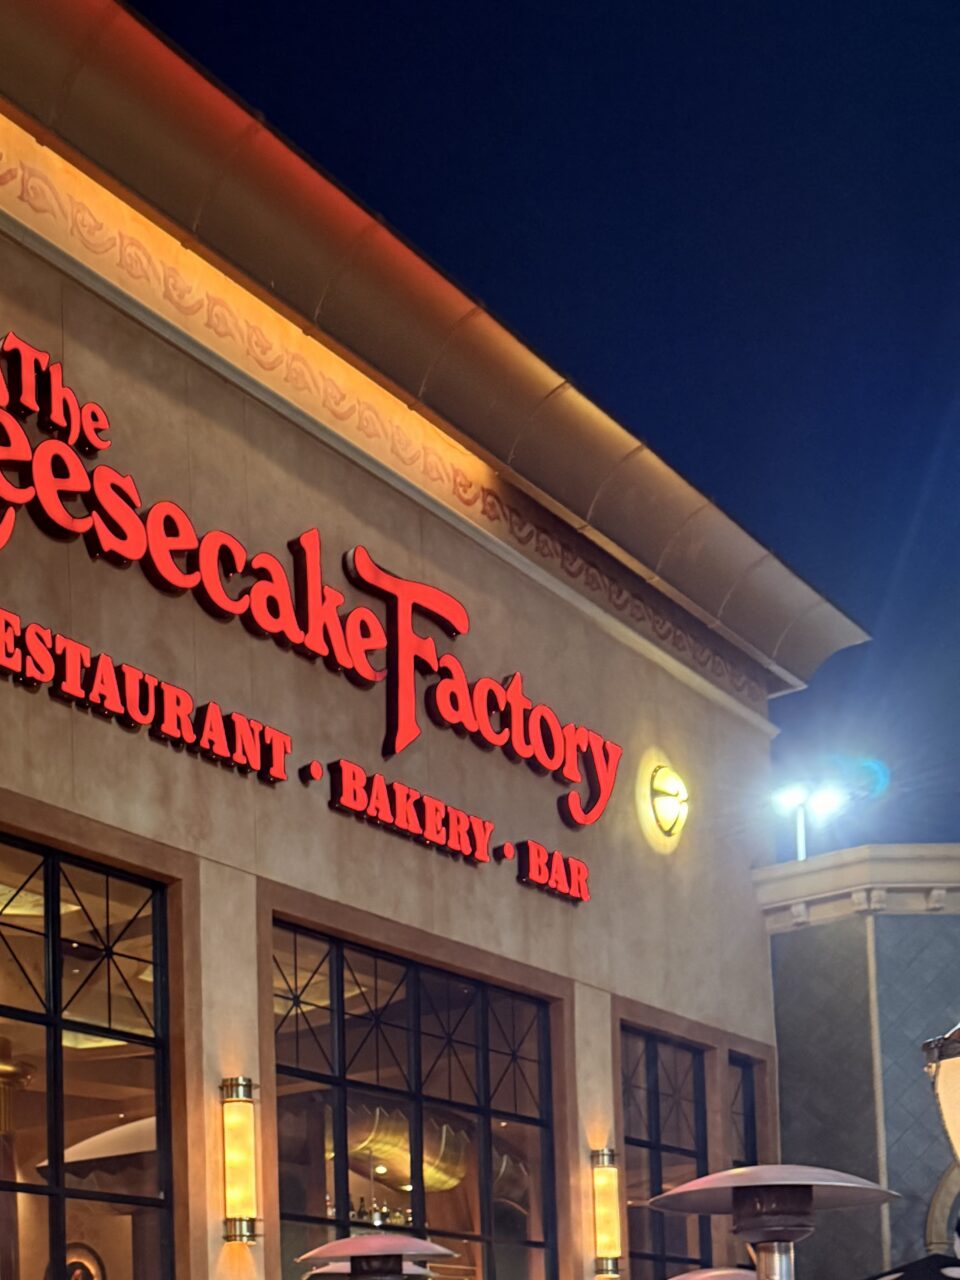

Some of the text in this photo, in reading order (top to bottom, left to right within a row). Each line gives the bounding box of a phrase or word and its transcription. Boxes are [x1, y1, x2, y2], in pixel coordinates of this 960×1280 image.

[2, 331, 112, 451] The
[354, 545, 624, 826] Factory
[339, 759, 495, 863] BAKERY
[527, 840, 591, 902] BAR
